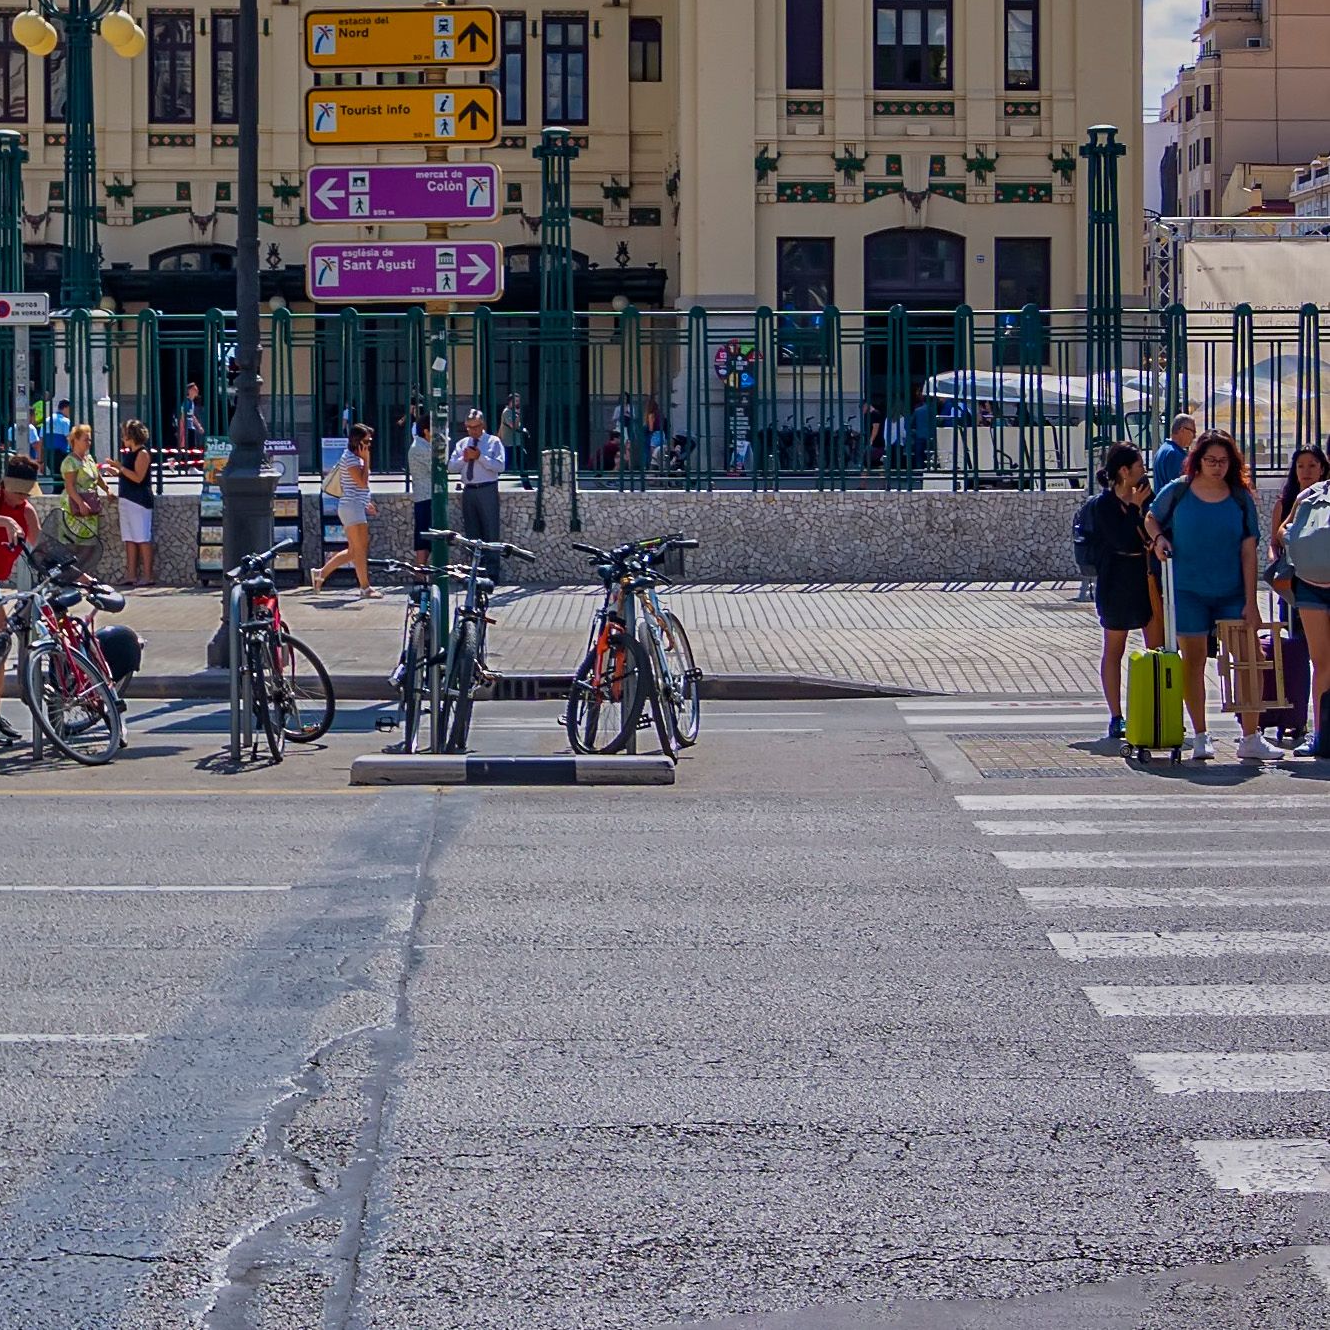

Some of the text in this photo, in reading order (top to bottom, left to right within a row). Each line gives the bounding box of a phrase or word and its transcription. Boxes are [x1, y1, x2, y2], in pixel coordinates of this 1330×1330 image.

[338, 16, 389, 26] estació del
[338, 27, 369, 38] Nord
[340, 103, 410, 116] Tourist info
[415, 170, 462, 179] mercat de
[382, 248, 394, 257] de
[342, 258, 416, 272] Sant Agustí
[205, 442, 233, 451] vida
